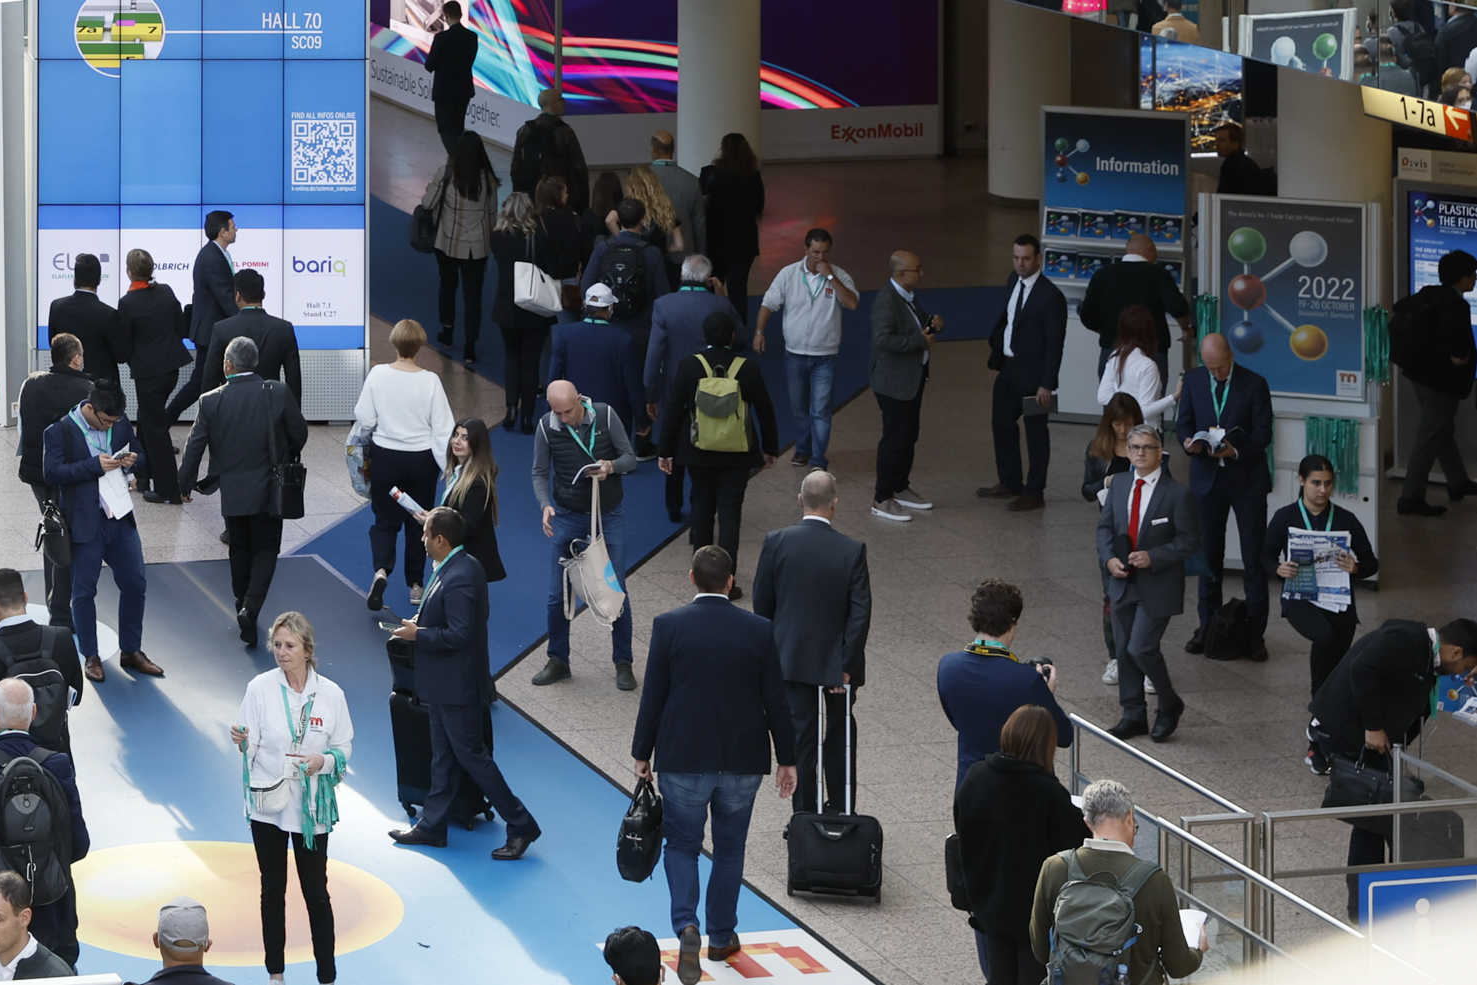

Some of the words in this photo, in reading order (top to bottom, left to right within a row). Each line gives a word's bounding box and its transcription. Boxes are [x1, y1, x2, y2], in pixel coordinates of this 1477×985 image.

[262, 13, 300, 29] HALL
[304, 12, 322, 29] 7.0
[291, 35, 322, 49] SC09
[370, 59, 417, 95] Sustainable
[465, 99, 501, 129] ogether.
[830, 123, 924, 144] ExxonMobil
[1096, 156, 1179, 176] Information
[1439, 215, 1456, 227] THE
[1298, 275, 1355, 301] 2022
[1321, 301, 1355, 311] OCTOBER
